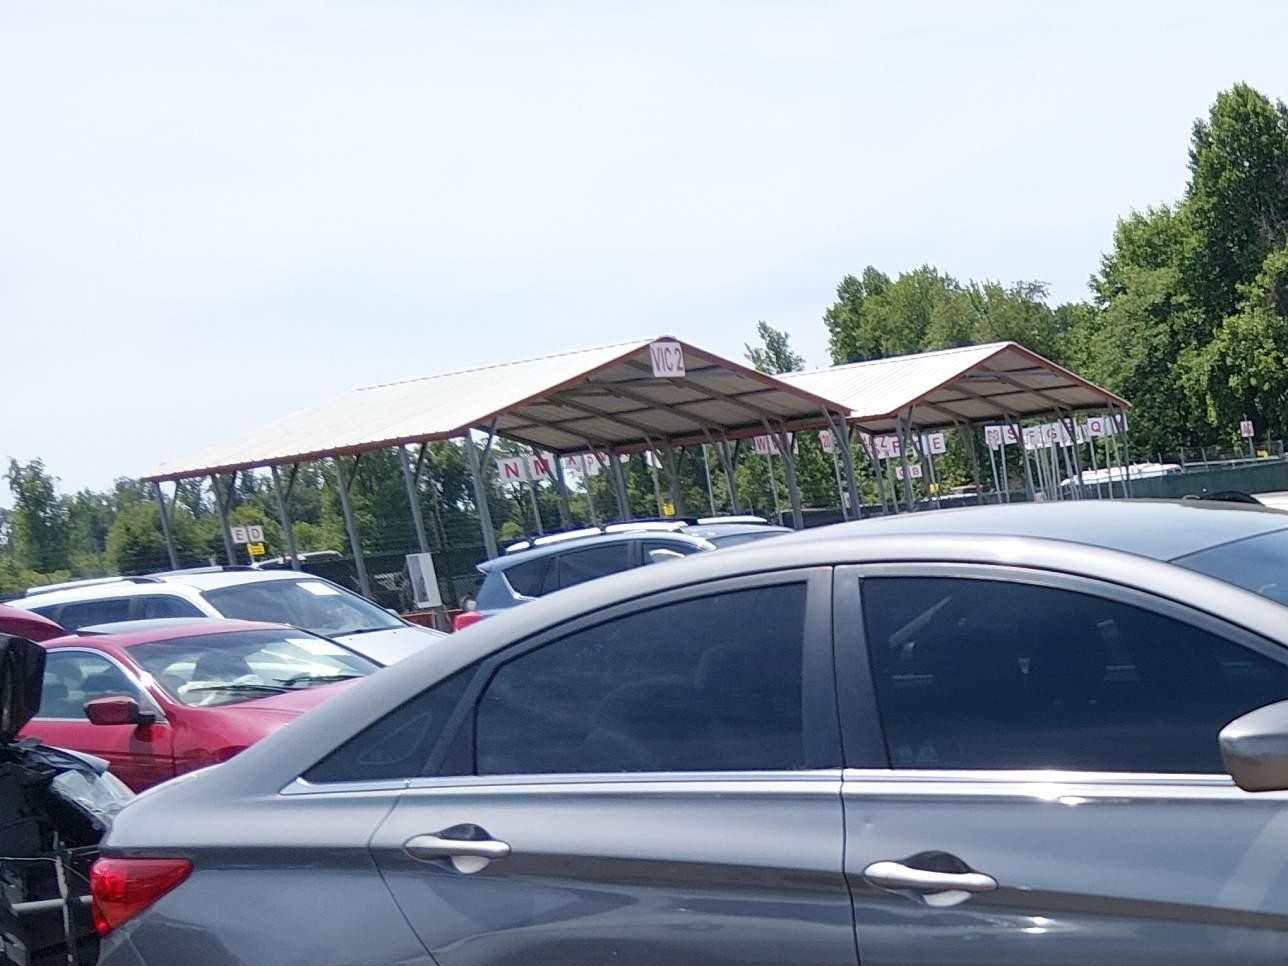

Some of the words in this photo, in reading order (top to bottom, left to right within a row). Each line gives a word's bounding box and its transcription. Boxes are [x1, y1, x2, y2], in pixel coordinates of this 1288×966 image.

[674, 347, 685, 371] 2
[1091, 421, 1101, 433] Q
[1047, 428, 1057, 440] G
[933, 437, 941, 450] E
[503, 461, 520, 478] N
[235, 529, 244, 541] E
[250, 528, 261, 540] D
